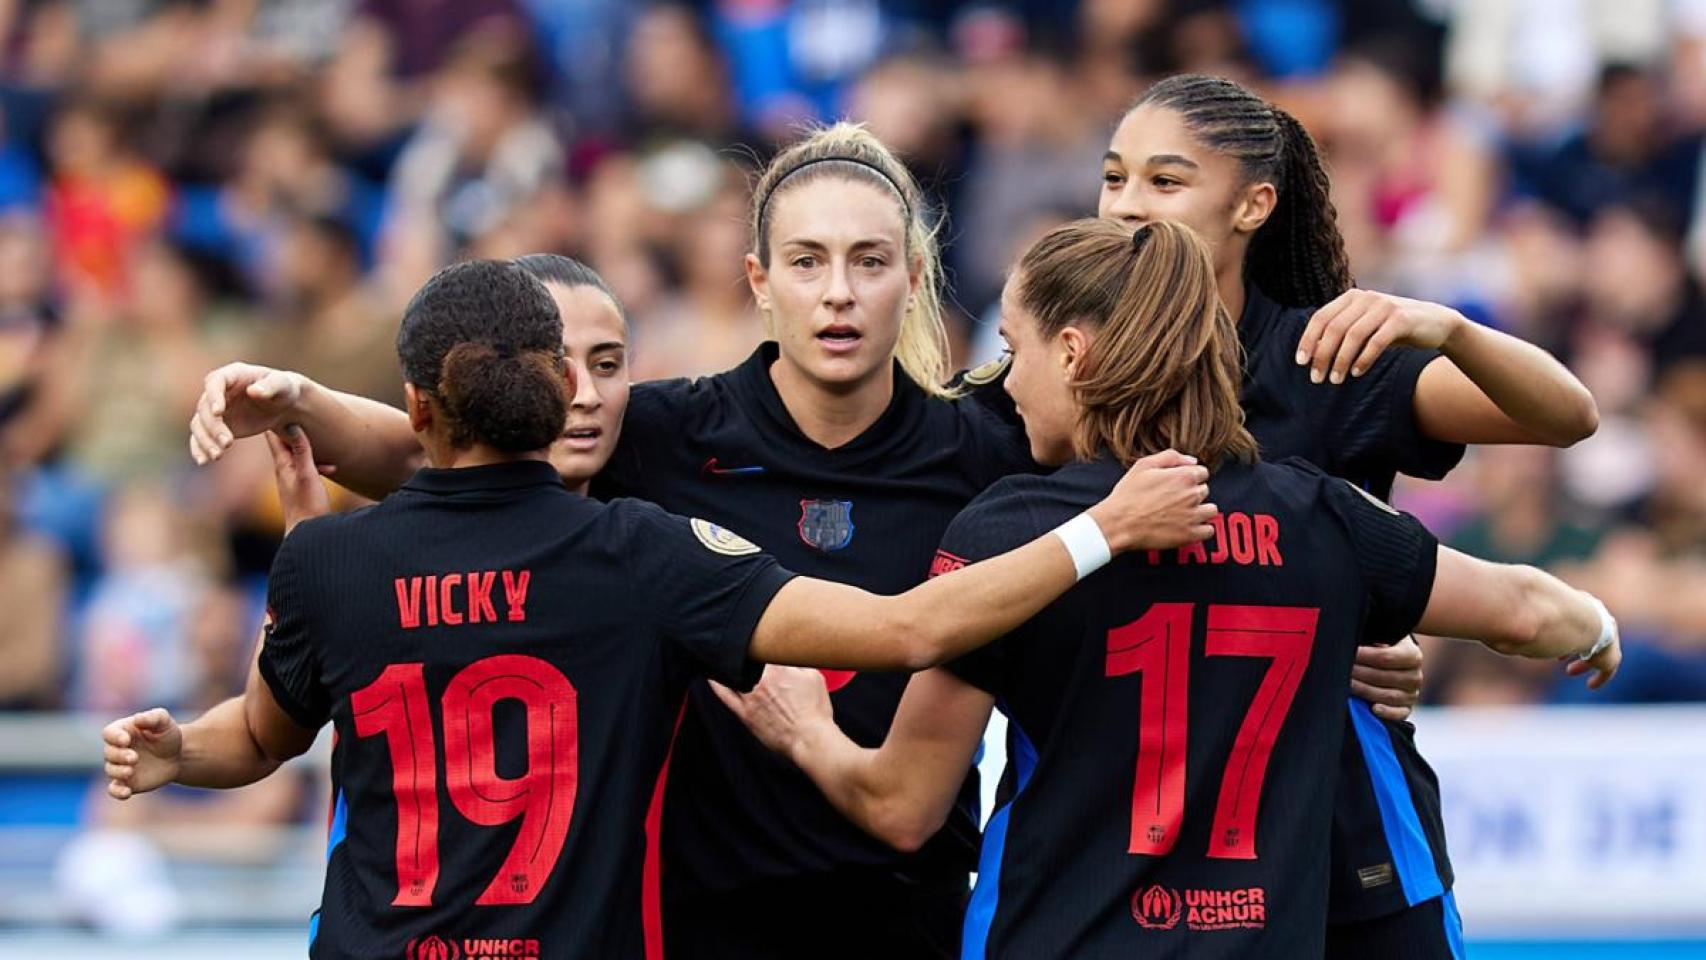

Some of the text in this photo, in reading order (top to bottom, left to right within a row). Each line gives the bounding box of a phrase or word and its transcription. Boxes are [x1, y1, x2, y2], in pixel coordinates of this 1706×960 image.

[1148, 511, 1283, 566] JOR
[395, 570, 531, 629] VICKY
[1105, 602, 1321, 860] 17
[351, 653, 578, 907] 19
[1185, 888, 1265, 907] UNHCR
[1187, 904, 1265, 923] ACNUR
[464, 939, 539, 955] UNHCR
